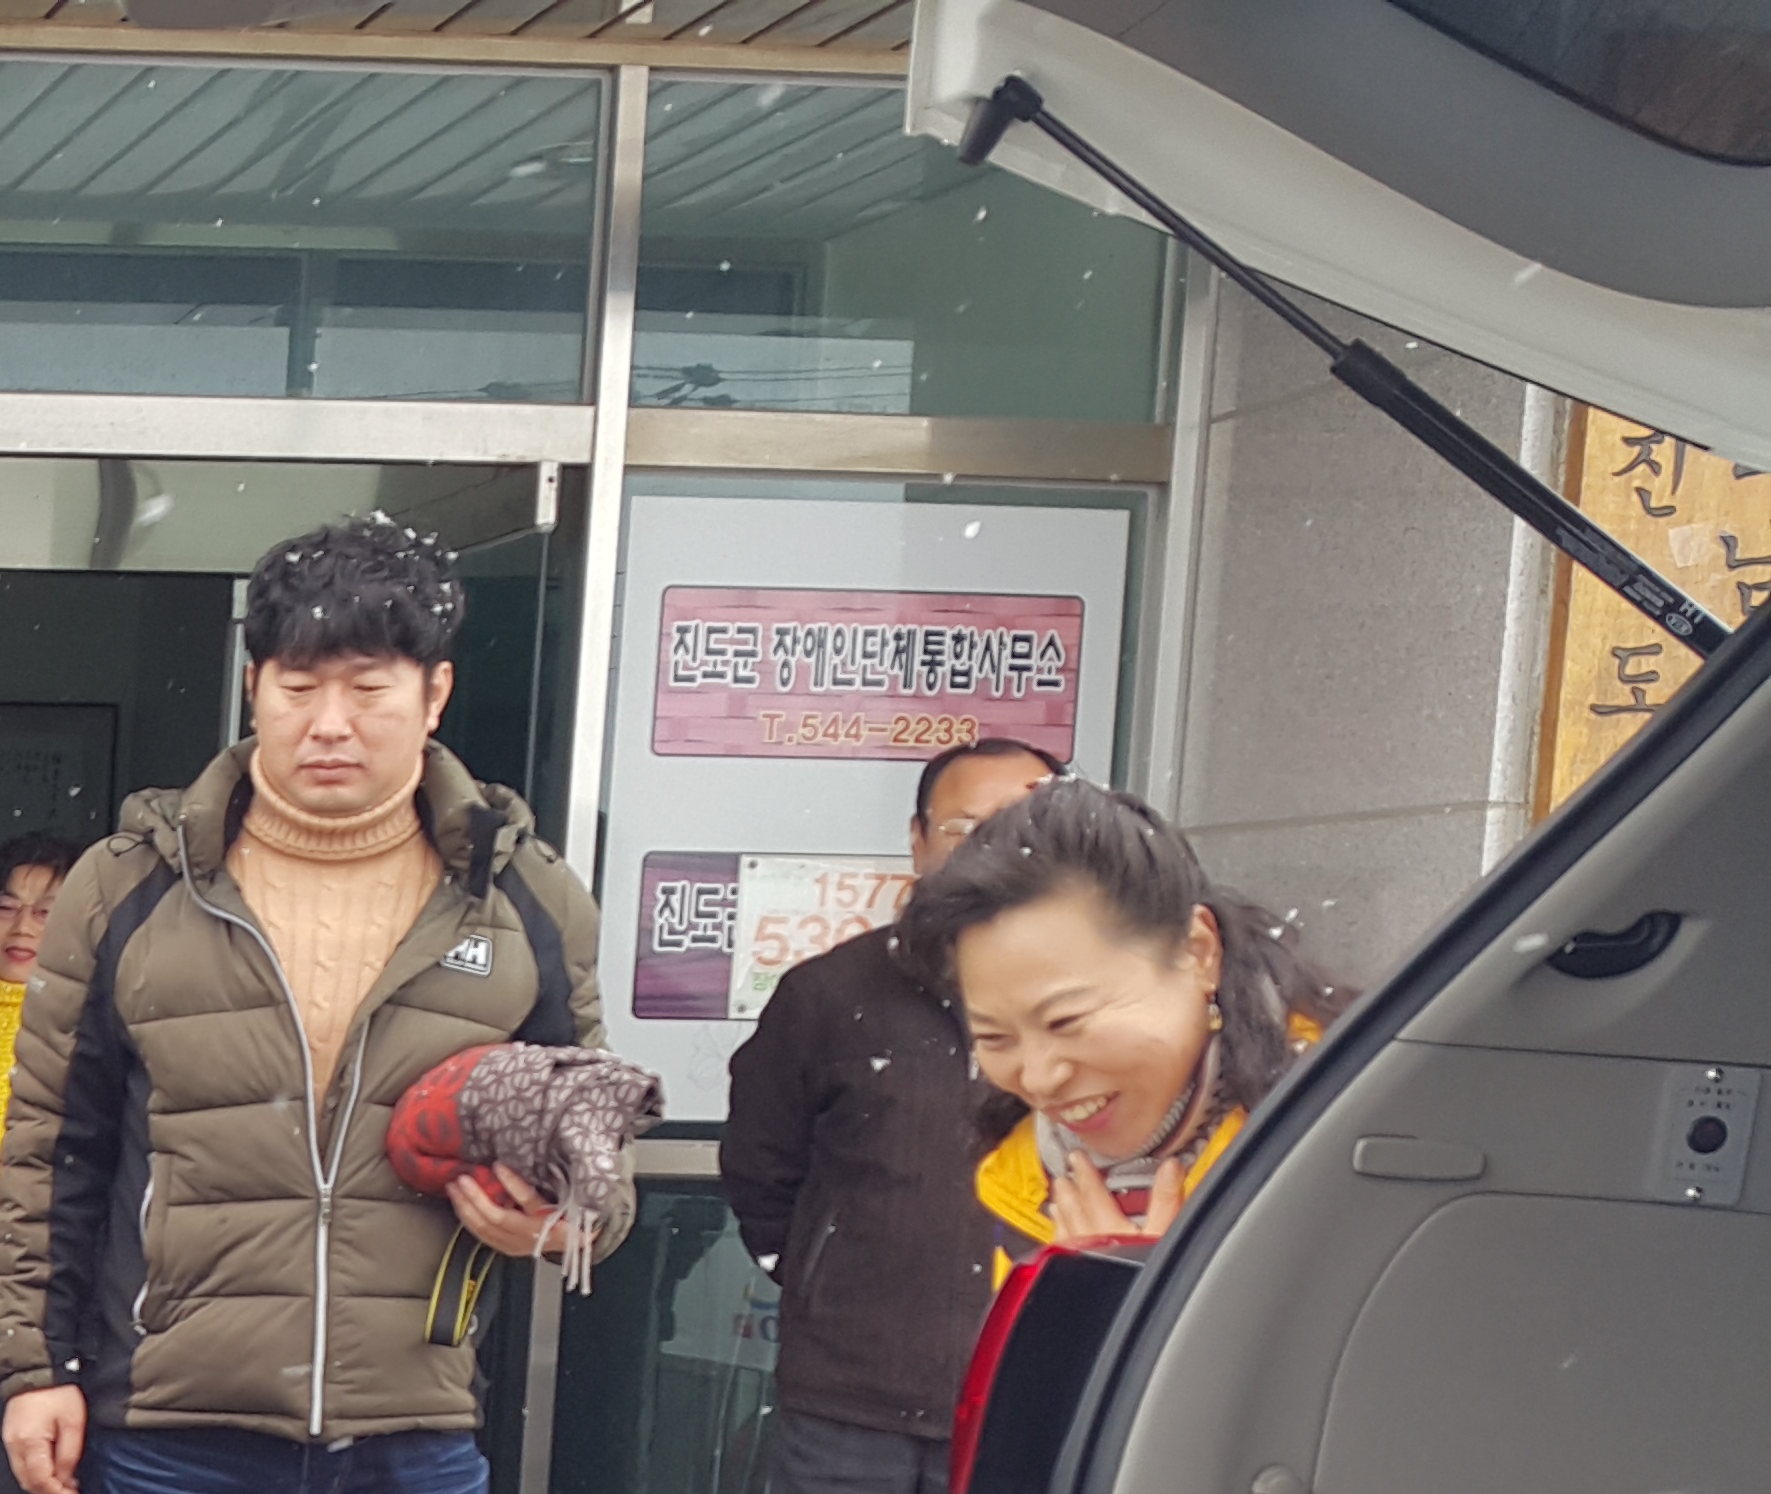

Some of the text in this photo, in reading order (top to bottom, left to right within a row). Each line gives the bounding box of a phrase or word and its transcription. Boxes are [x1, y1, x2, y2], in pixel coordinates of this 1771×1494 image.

[669, 621, 1065, 696] 진도군 장애인단체통합사무소
[762, 712, 979, 747] T.544-2233
